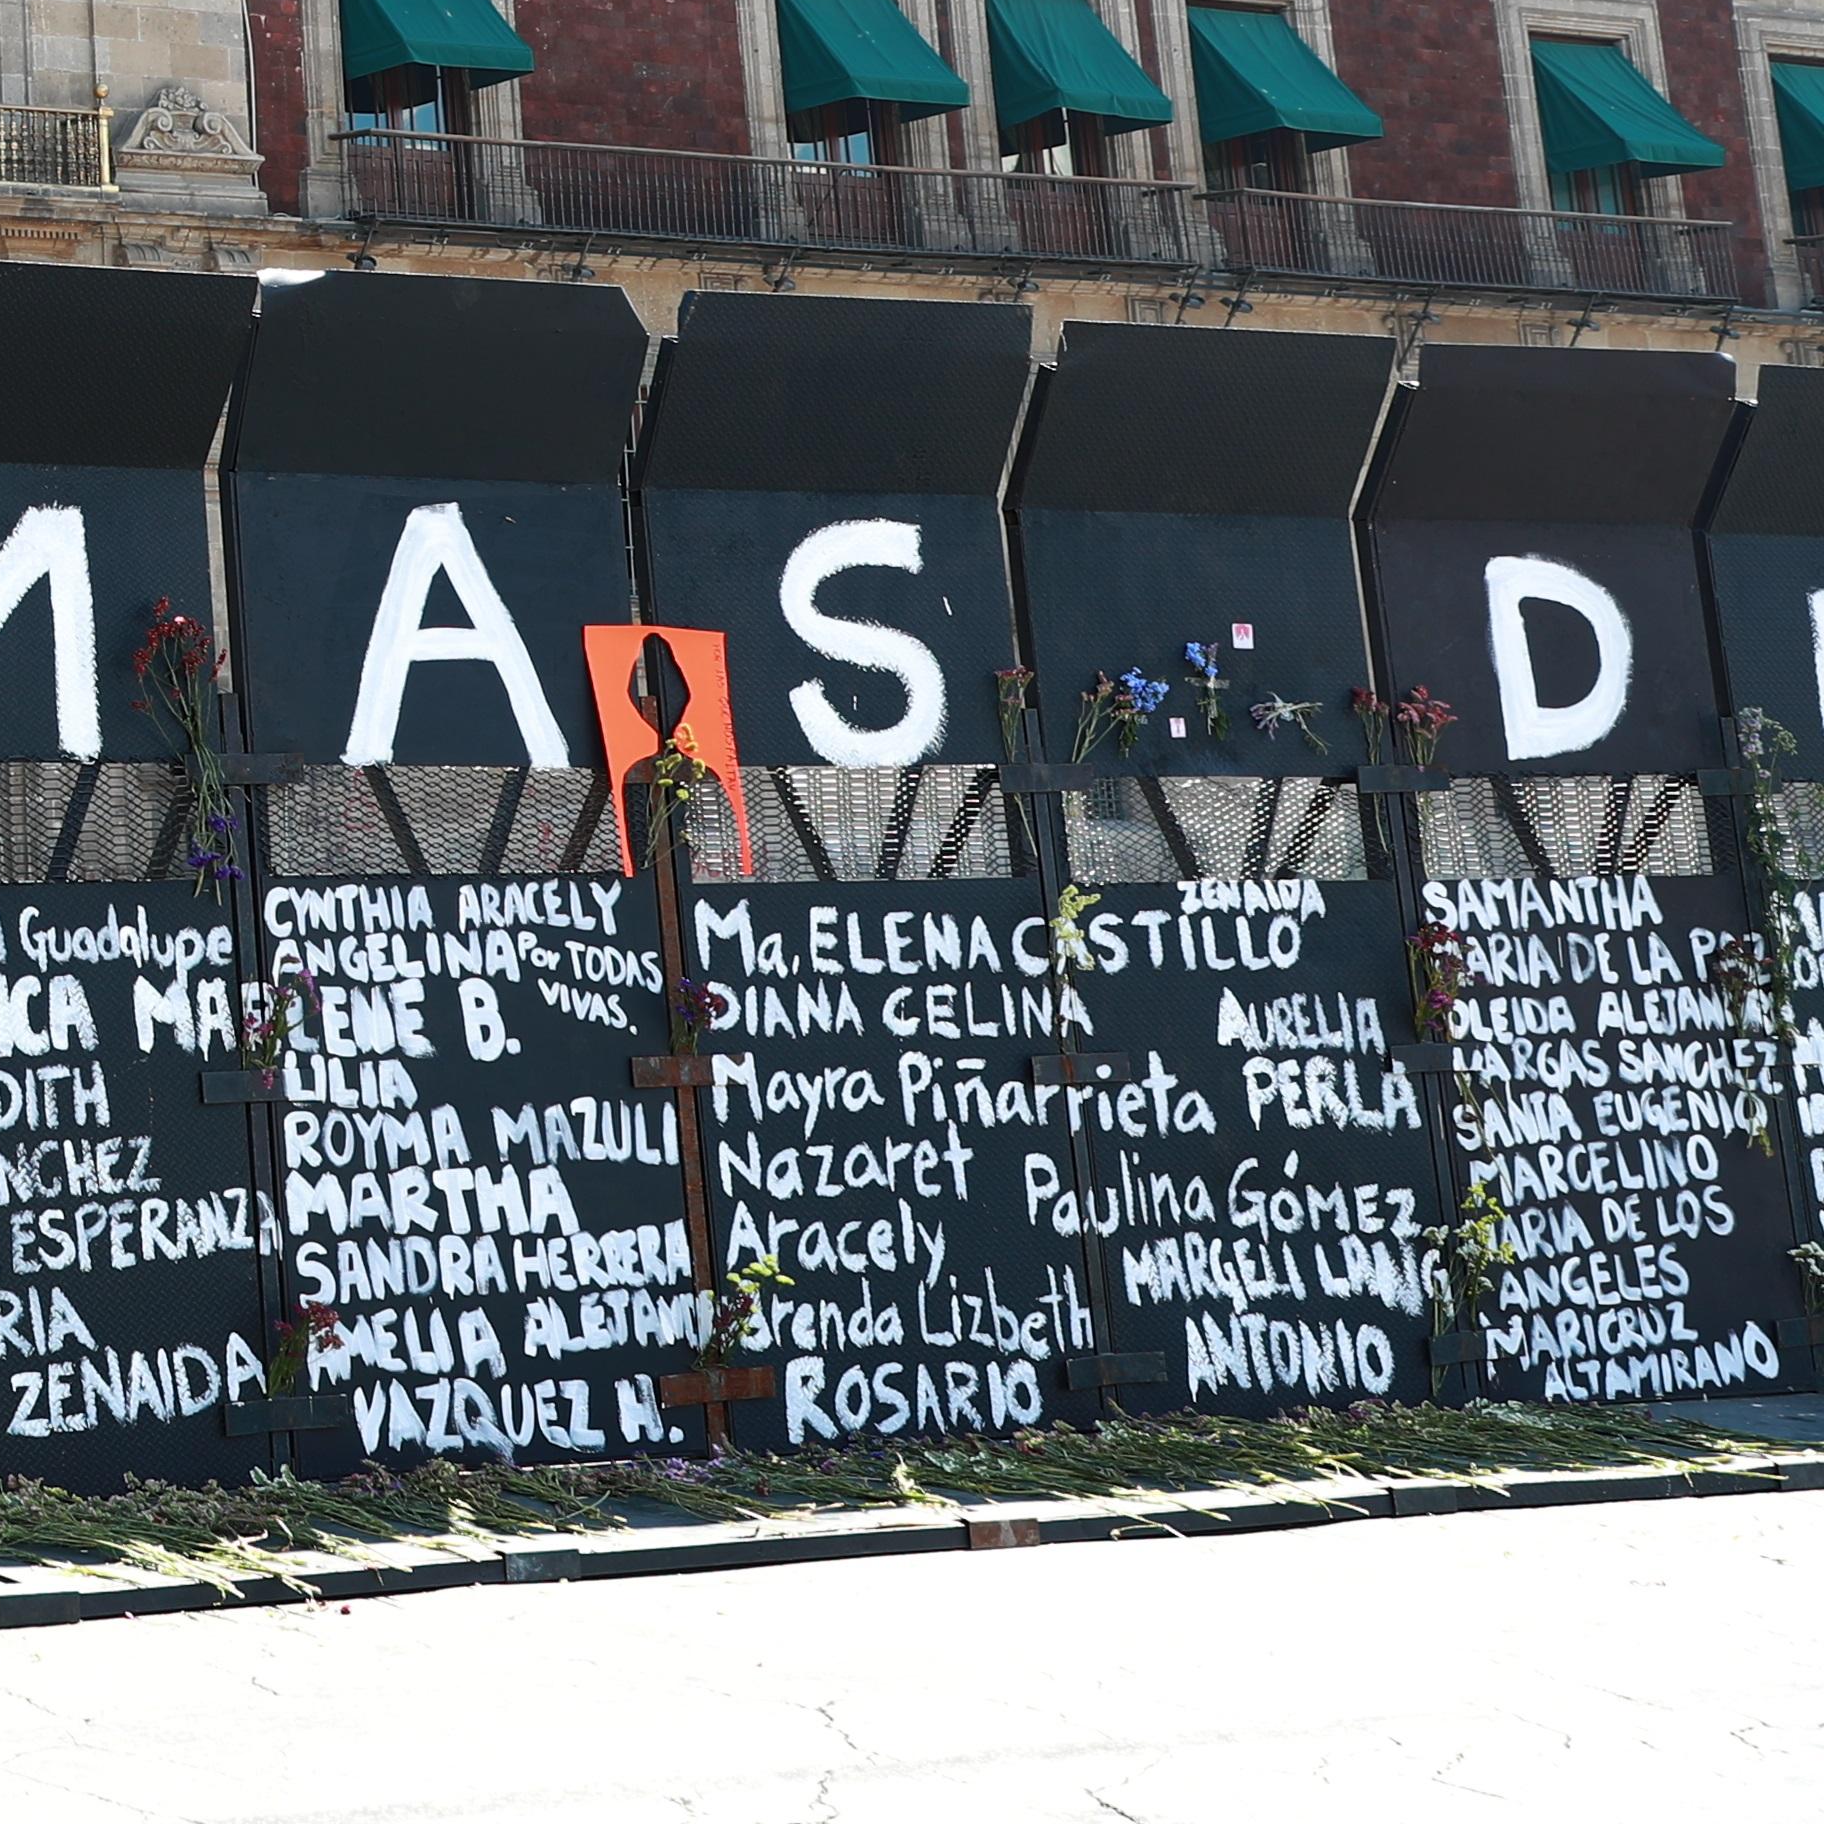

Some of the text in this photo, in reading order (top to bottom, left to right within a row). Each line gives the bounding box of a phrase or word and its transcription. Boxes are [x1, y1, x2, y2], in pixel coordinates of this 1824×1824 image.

[264, 879, 621, 939] CYNTHIA ARACELY
[1177, 878, 1326, 924] ZENAIDA
[1422, 875, 1663, 933] SAMANTHA
[18, 904, 233, 982] Guadalupe
[272, 931, 521, 985] ANGELINA
[565, 942, 662, 993] TODAS
[808, 906, 1001, 975] ELENA
[1567, 932, 1619, 984] DE
[1627, 931, 1684, 985] LA
[458, 977, 521, 1062] B.
[538, 979, 638, 1035] VIVAS.
[706, 978, 1093, 1039] DIANA CELINA
[1217, 986, 1387, 1056] AURELIA
[281, 1050, 418, 1109] LILIA
[711, 1052, 885, 1140] Mayra
[1241, 1055, 1422, 1136] PERLA
[1453, 1037, 1610, 1096] VARGAS
[1618, 1038, 1783, 1095] SANCHEZ
[283, 1096, 680, 1171] ROYMA MAZULI
[1453, 1078, 1582, 1151] SANTA
[718, 1120, 975, 1200] Nazaret
[1024, 1150, 1216, 1238] Paulina
[1469, 1135, 1718, 1207] MARCELINO
[10, 1187, 283, 1275] ESPERANZA
[285, 1166, 580, 1236] MARTHA
[1602, 1193, 1647, 1243] DE
[1659, 1185, 1736, 1239] LOS
[295, 1218, 692, 1306] SANDRA HERRERA
[726, 1198, 946, 1288] Aracely
[1499, 1242, 1690, 1312] ANGELES
[918, 1265, 1093, 1360] Lizbeth
[1479, 1302, 1698, 1381] MARICRUZ
[5, 1331, 268, 1438] ZENAIDA
[1185, 1311, 1395, 1403] ANTONIO
[1545, 1321, 1779, 1401] ALTAMIRANO
[353, 1377, 608, 1459] VAZQUEZ
[784, 1356, 1043, 1445] ROSARIO
